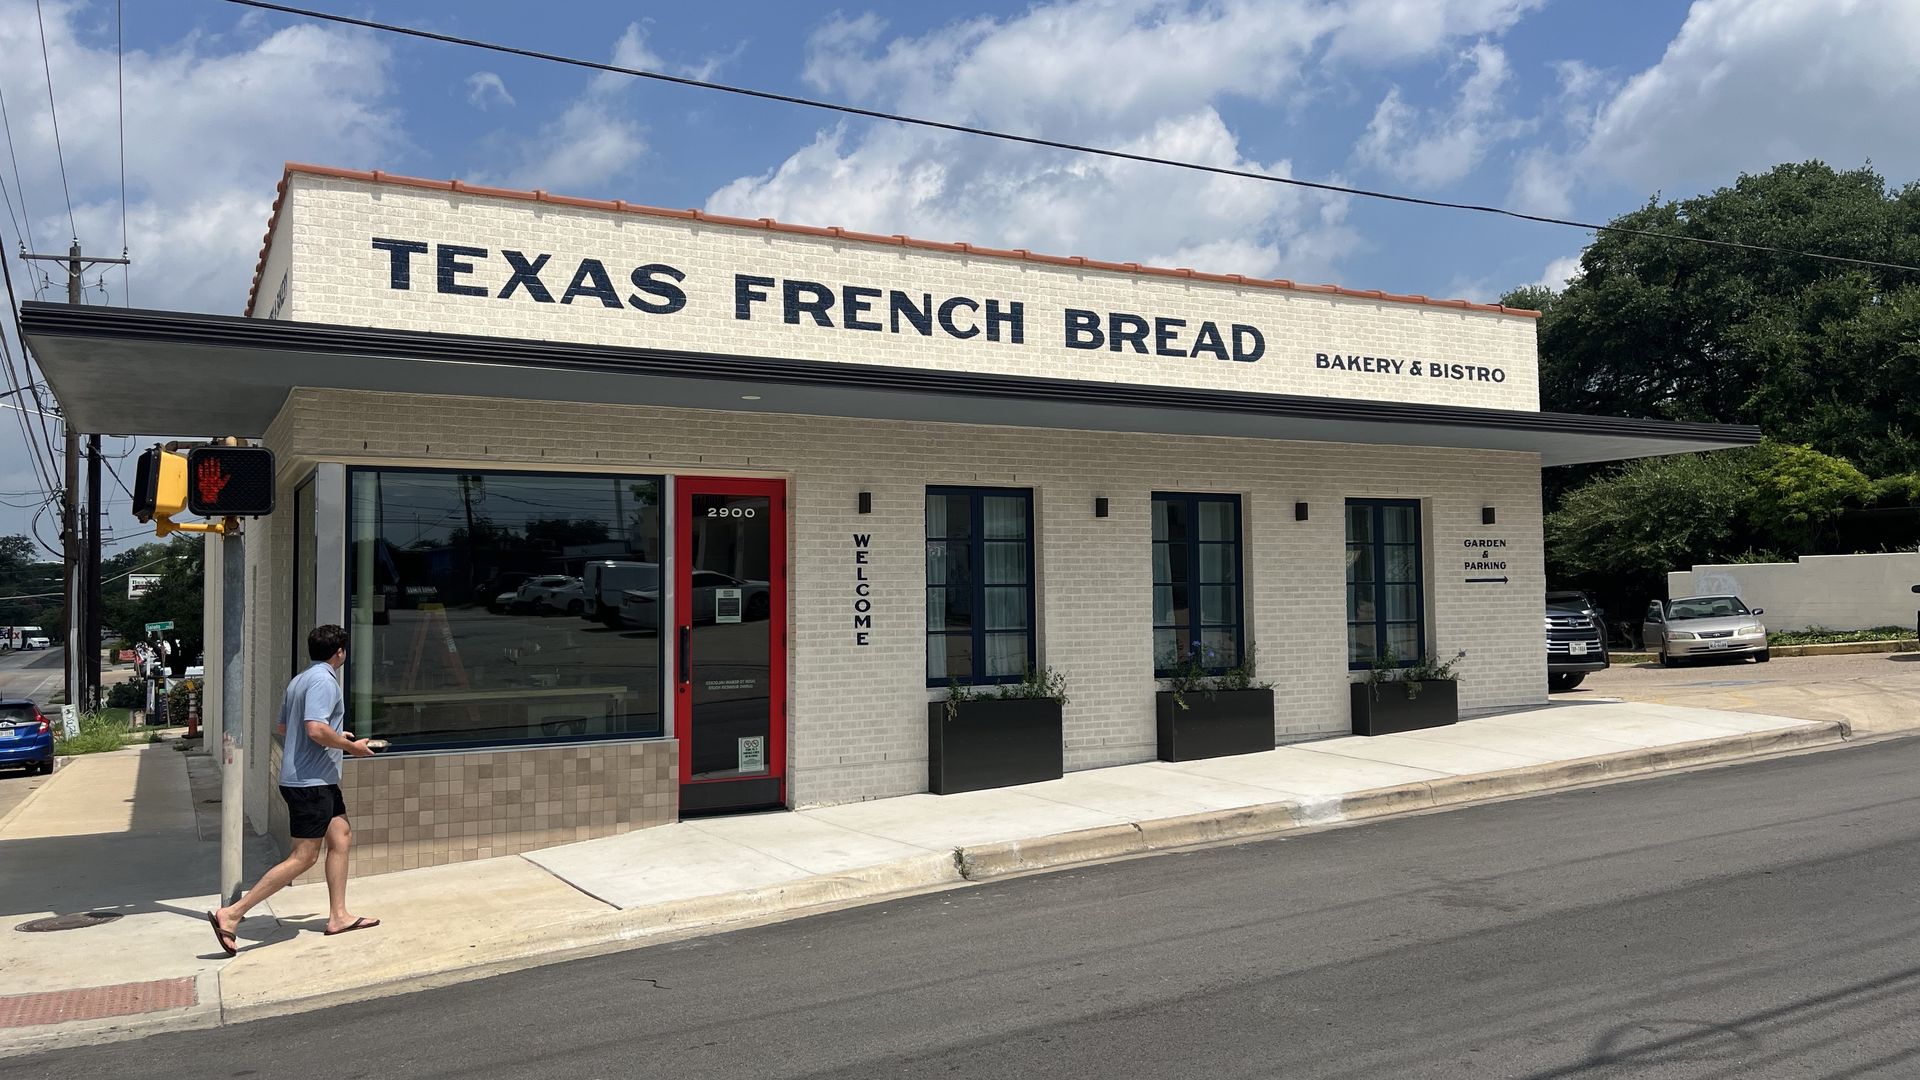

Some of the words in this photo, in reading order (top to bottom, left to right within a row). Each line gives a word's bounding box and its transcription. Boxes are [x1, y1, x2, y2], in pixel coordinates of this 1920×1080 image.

[372, 237, 687, 314] TEXAS
[735, 274, 1024, 344] FRENCH
[1065, 308, 1265, 362] BREAD
[1316, 353, 1404, 374] BAKERY
[1409, 361, 1423, 376] &
[1430, 363, 1506, 383] BISTRO
[707, 508, 755, 518] 2900
[1464, 539, 1506, 548] GARDEN
[1482, 550, 1489, 559] &
[1464, 561, 1507, 570] PARKING
[853, 534, 871, 646] WELCOME
